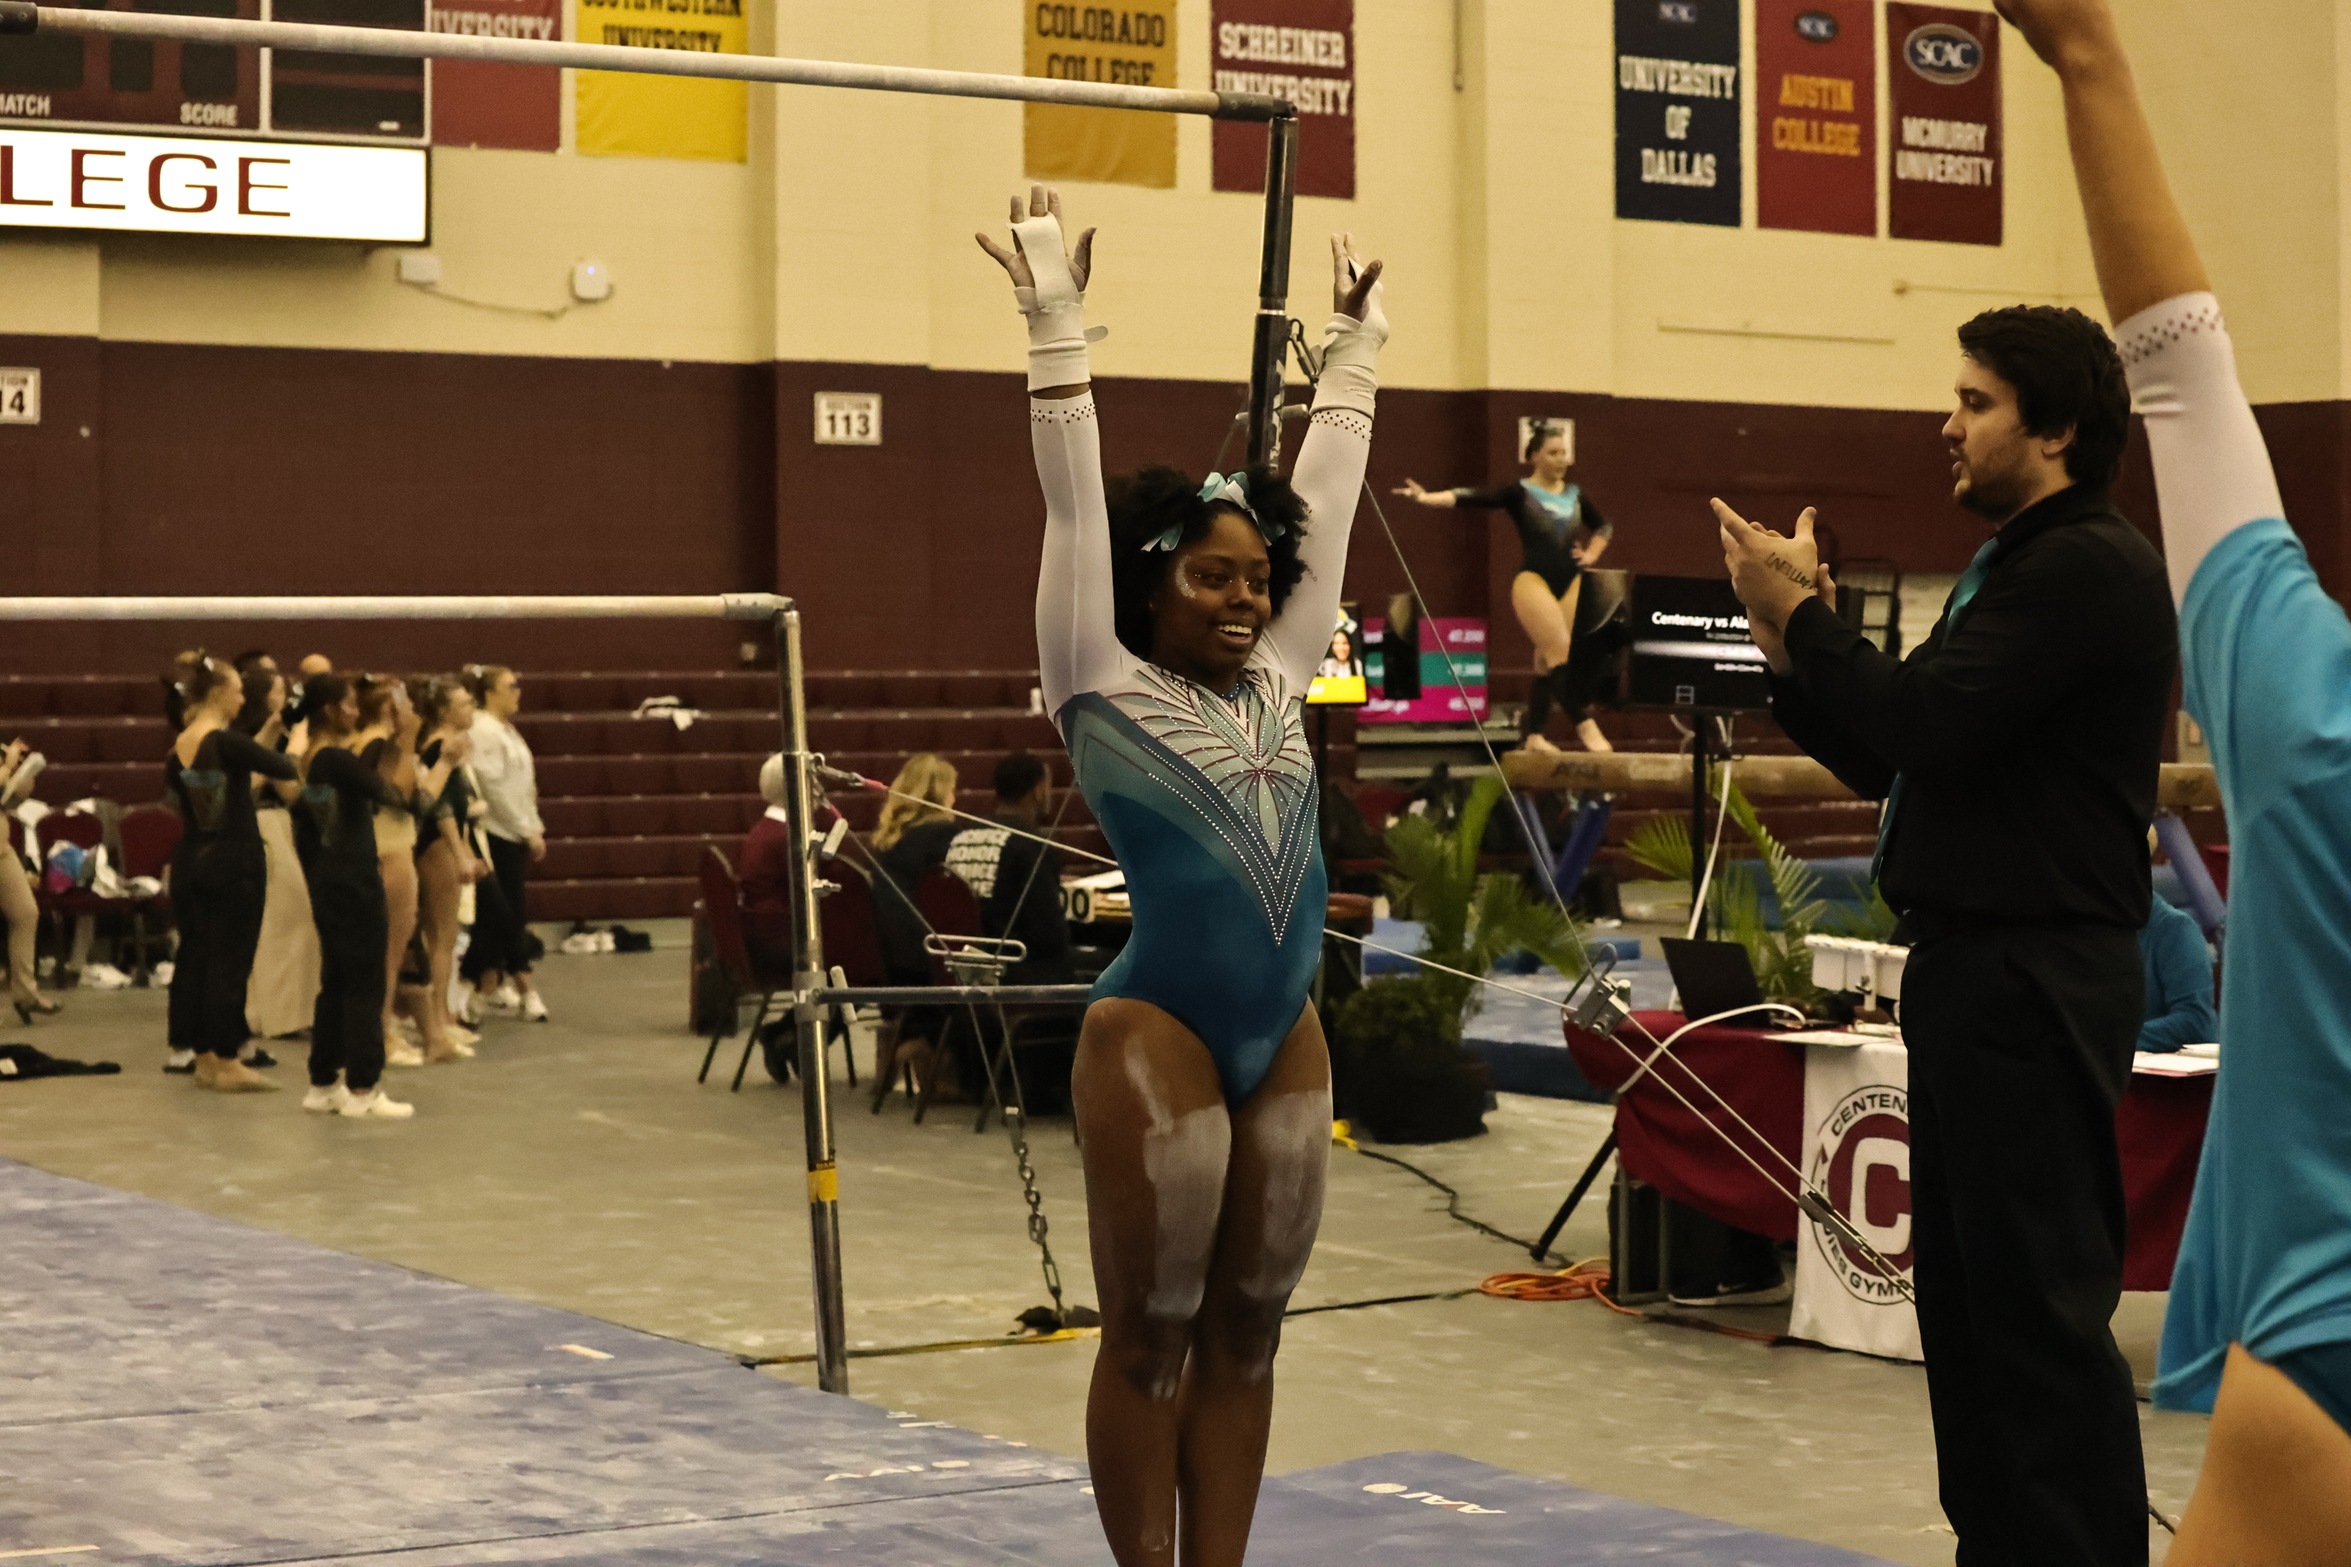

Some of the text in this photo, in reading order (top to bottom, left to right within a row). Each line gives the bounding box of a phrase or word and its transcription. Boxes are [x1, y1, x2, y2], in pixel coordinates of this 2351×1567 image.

[1037, 3, 1166, 47] COLORADO
[1219, 22, 1346, 68] SCHREINER
[1916, 38, 1973, 69] SCAC
[1046, 53, 1155, 85] COLLEGE
[1620, 55, 1736, 99] UNIVERSITY
[1215, 69, 1351, 116] UNIVERSITY
[1779, 73, 1854, 112] AUSTIN
[180, 102, 238, 127] SCORE
[1665, 104, 1691, 140] OF
[1772, 116, 1861, 156] COLLEGE
[0, 144, 291, 217] LEGE
[1641, 147, 1717, 188] DALLAS
[1896, 149, 1994, 188] UNIVERSITY
[827, 413, 870, 436] 113
[1651, 611, 1714, 630] Centenary
[1714, 616, 1729, 628] vs
